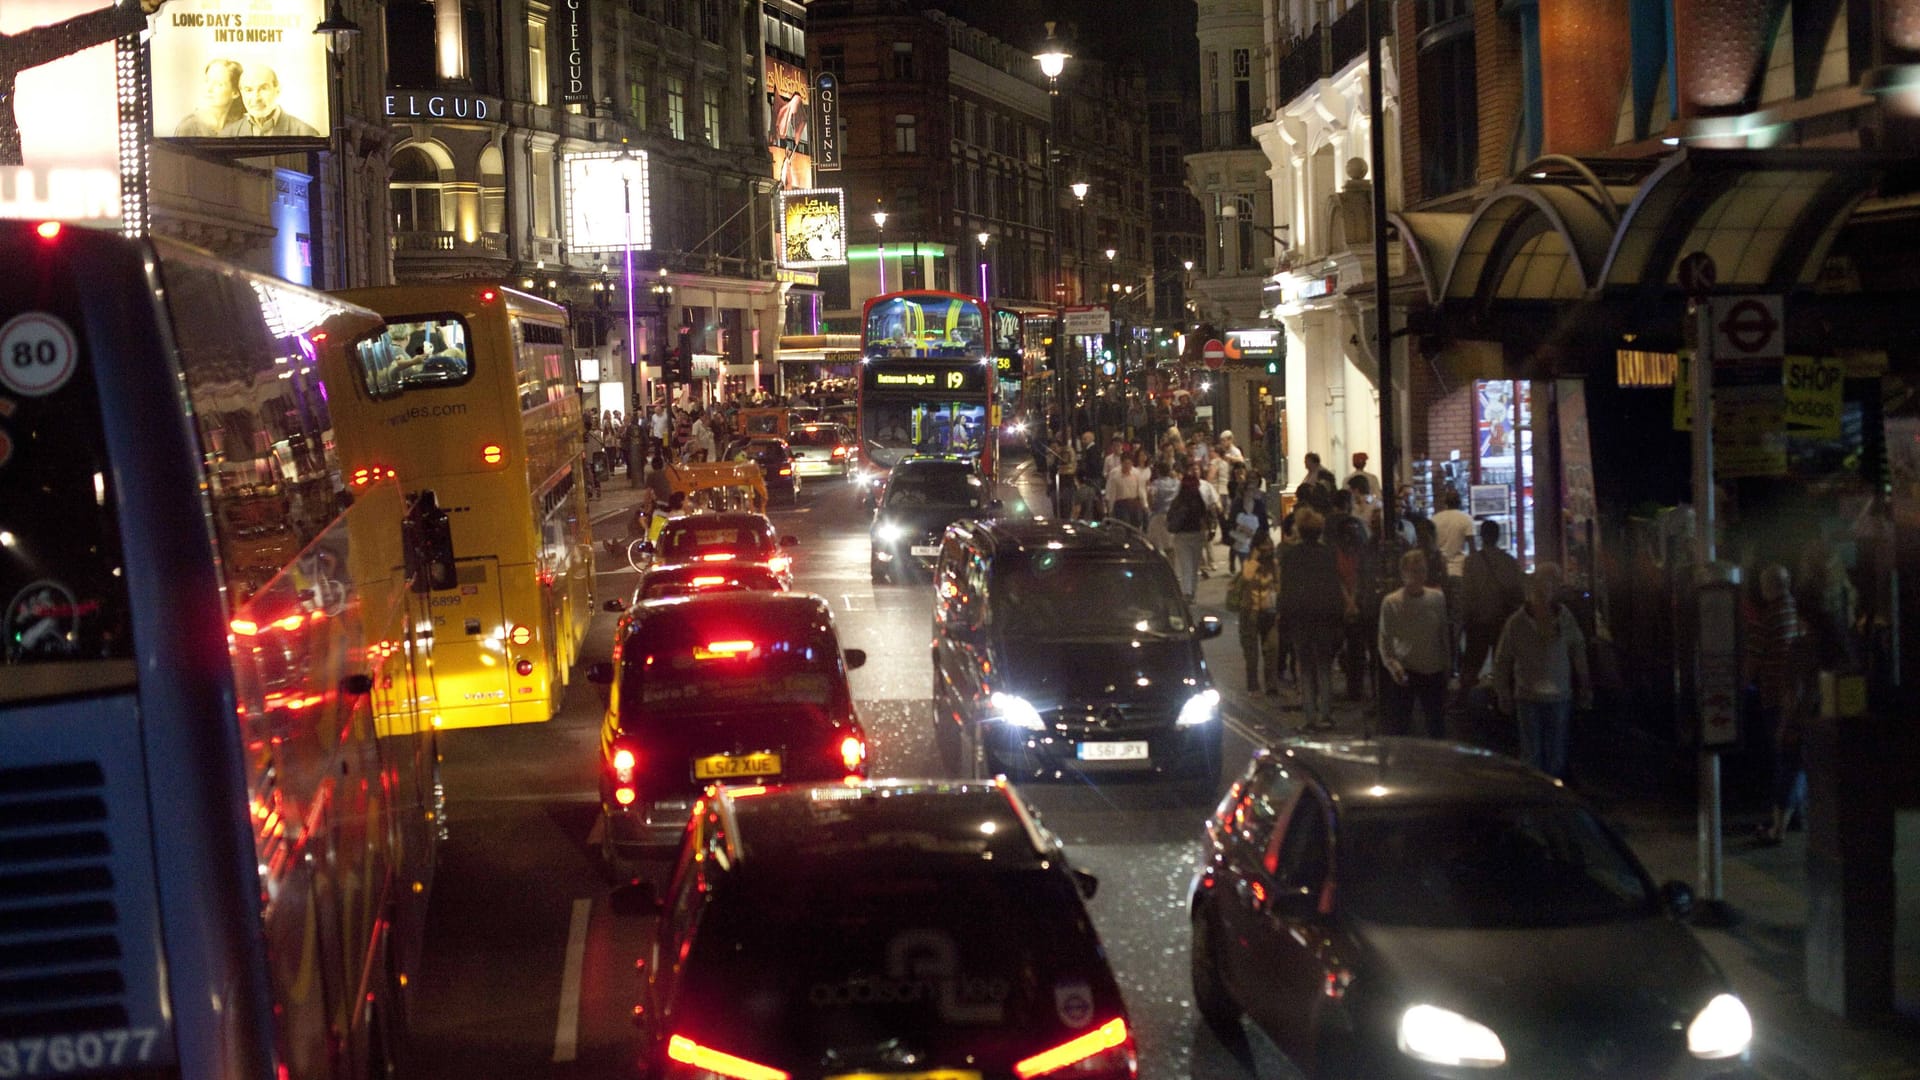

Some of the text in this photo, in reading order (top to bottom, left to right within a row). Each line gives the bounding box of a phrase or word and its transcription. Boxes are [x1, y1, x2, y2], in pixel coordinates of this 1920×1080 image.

[172, 13, 204, 27] LONG
[206, 13, 242, 27] DAY'S
[215, 29, 283, 42] INTO NIGHT
[821, 90, 834, 162] QUEENS
[804, 196, 818, 206] Les
[12, 339, 57, 369] 80
[838, 353, 859, 361] HOUS
[997, 358, 1010, 369] 38
[947, 371, 964, 389] 19
[1789, 364, 1840, 391] SHOP
[743, 758, 771, 772] XUE
